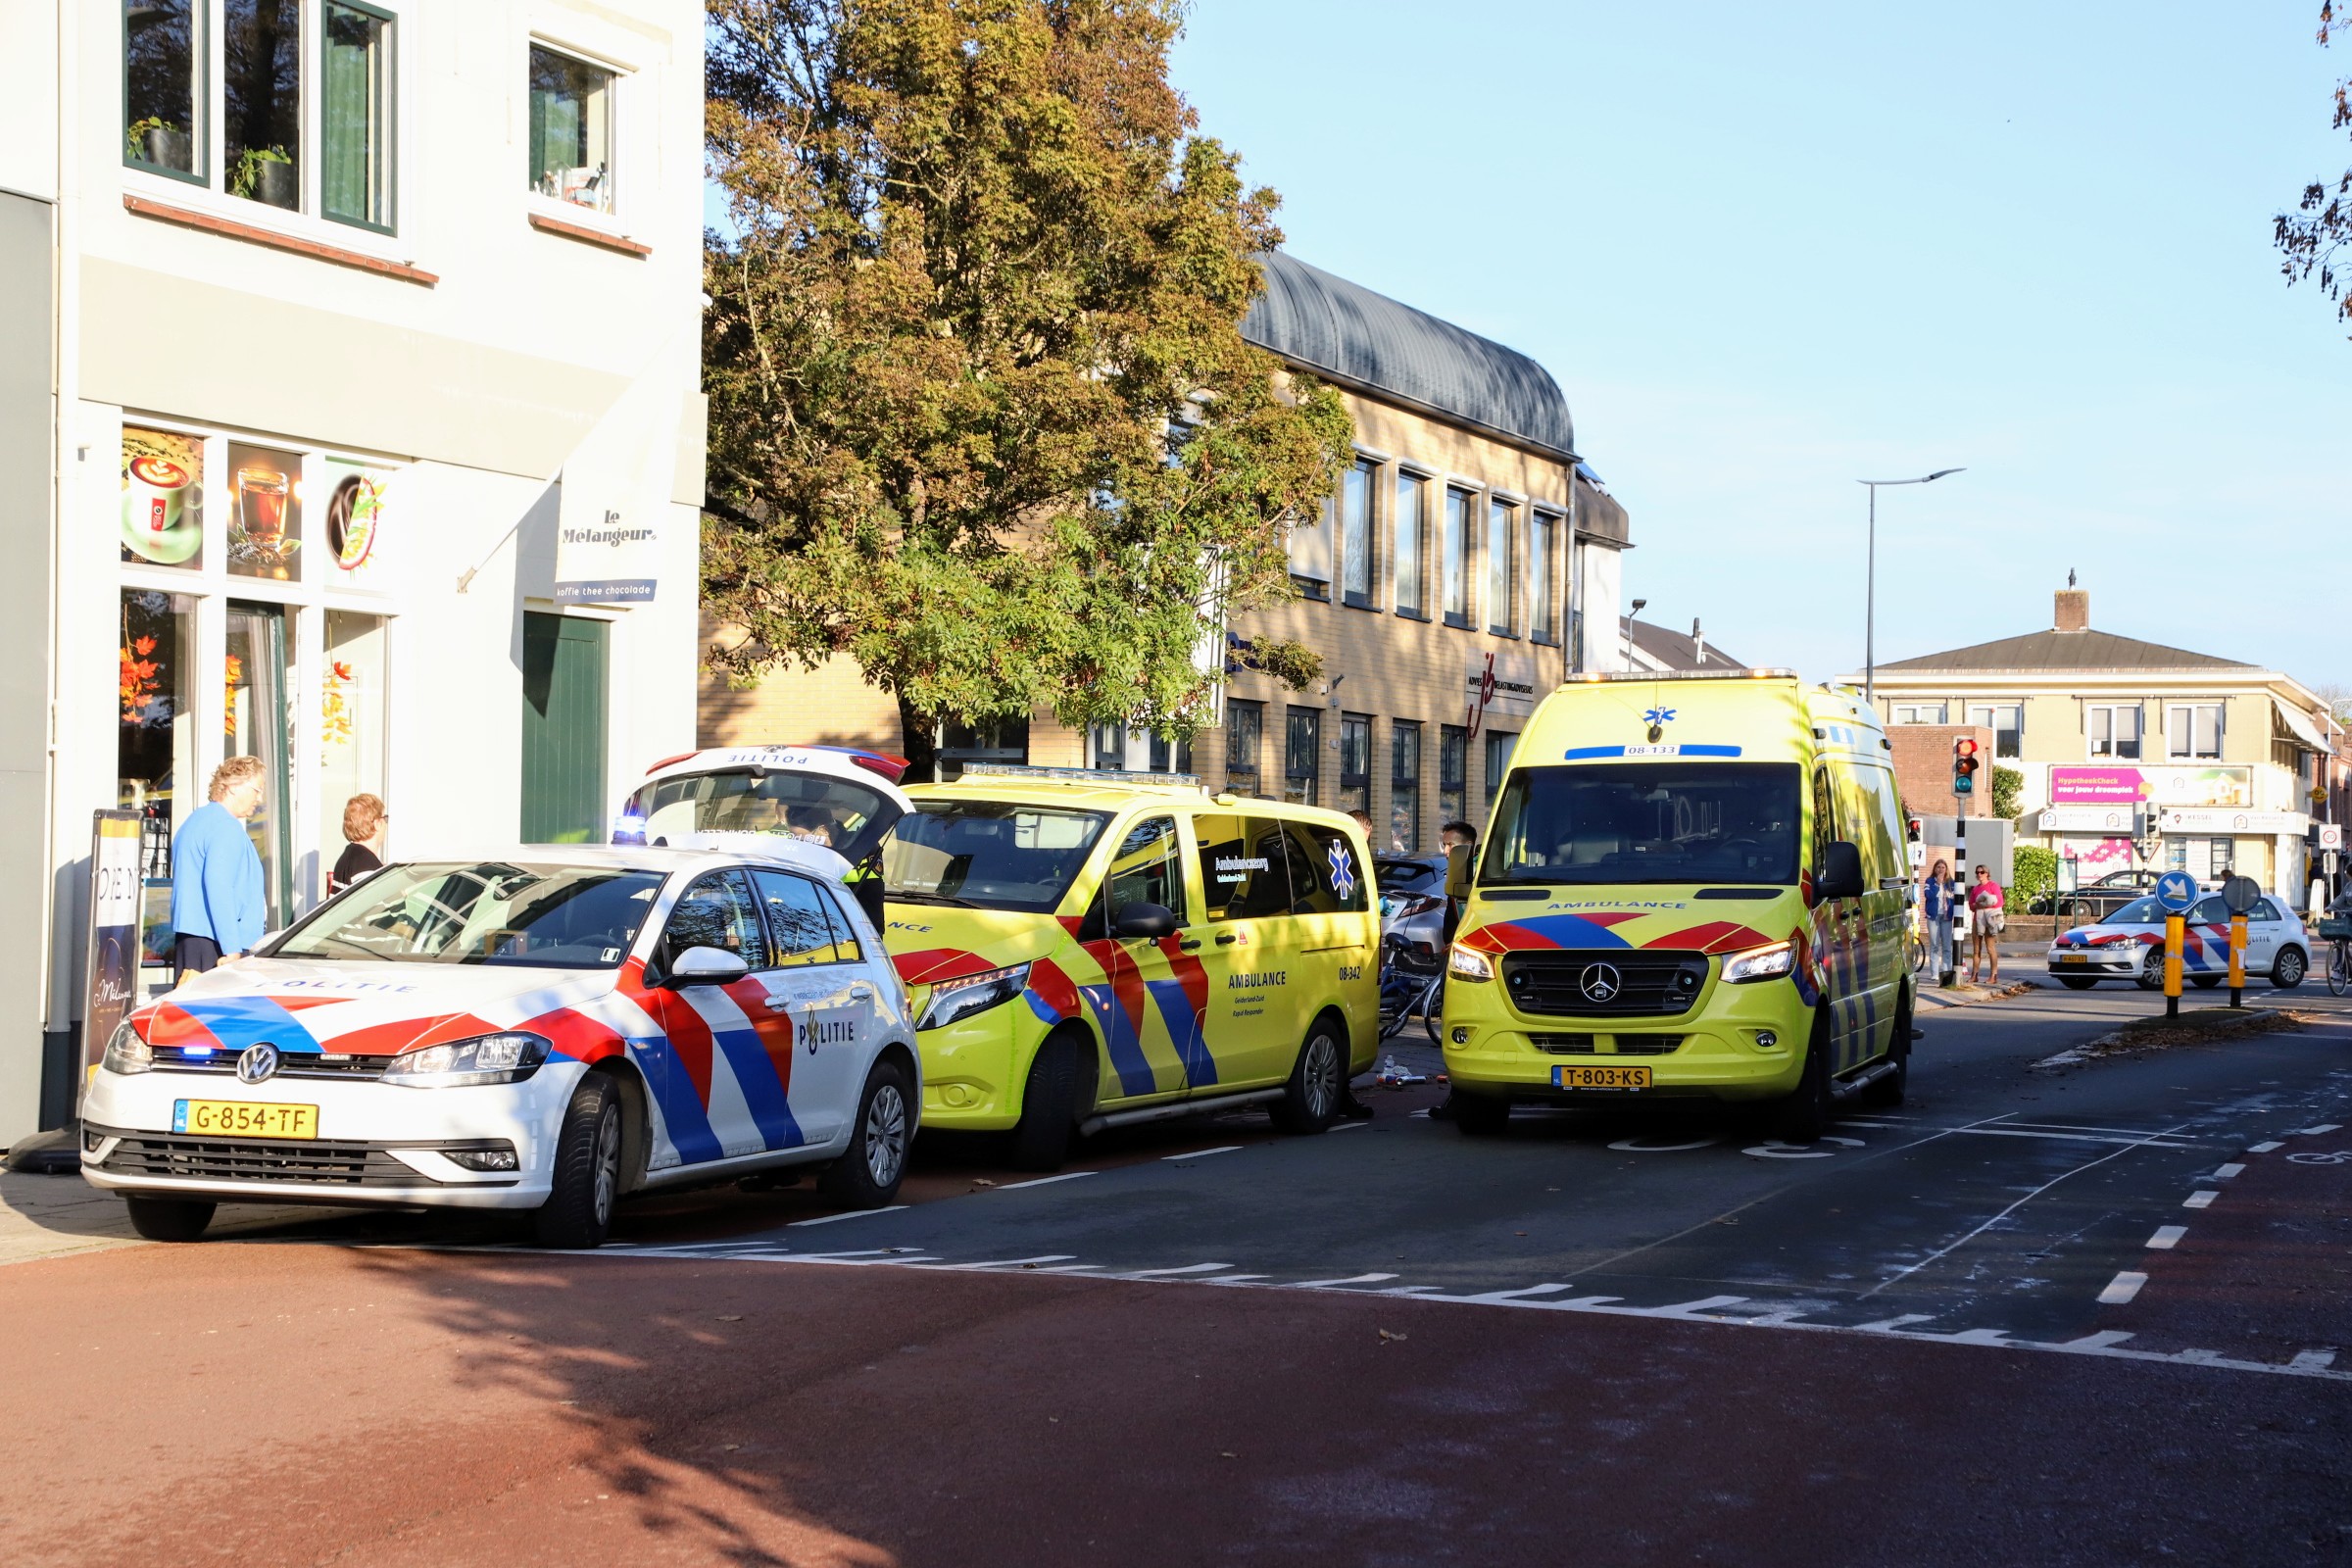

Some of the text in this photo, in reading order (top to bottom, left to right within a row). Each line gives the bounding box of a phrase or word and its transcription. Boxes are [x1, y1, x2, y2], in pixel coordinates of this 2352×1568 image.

[557, 584, 651, 597] koffie thee chocolade
[1628, 746, 1676, 755] 08-133
[727, 755, 808, 764] POLITIE
[2057, 777, 2119, 786] HypotheekCheck
[2075, 785, 2094, 795] jouw
[1215, 856, 1269, 872] Ambulancezorg
[1339, 966, 1361, 980] 08-342
[1228, 971, 1286, 989] AMBULANCE
[1566, 1069, 1644, 1086] T-803-KS
[196, 1105, 306, 1132] G-854-TF
